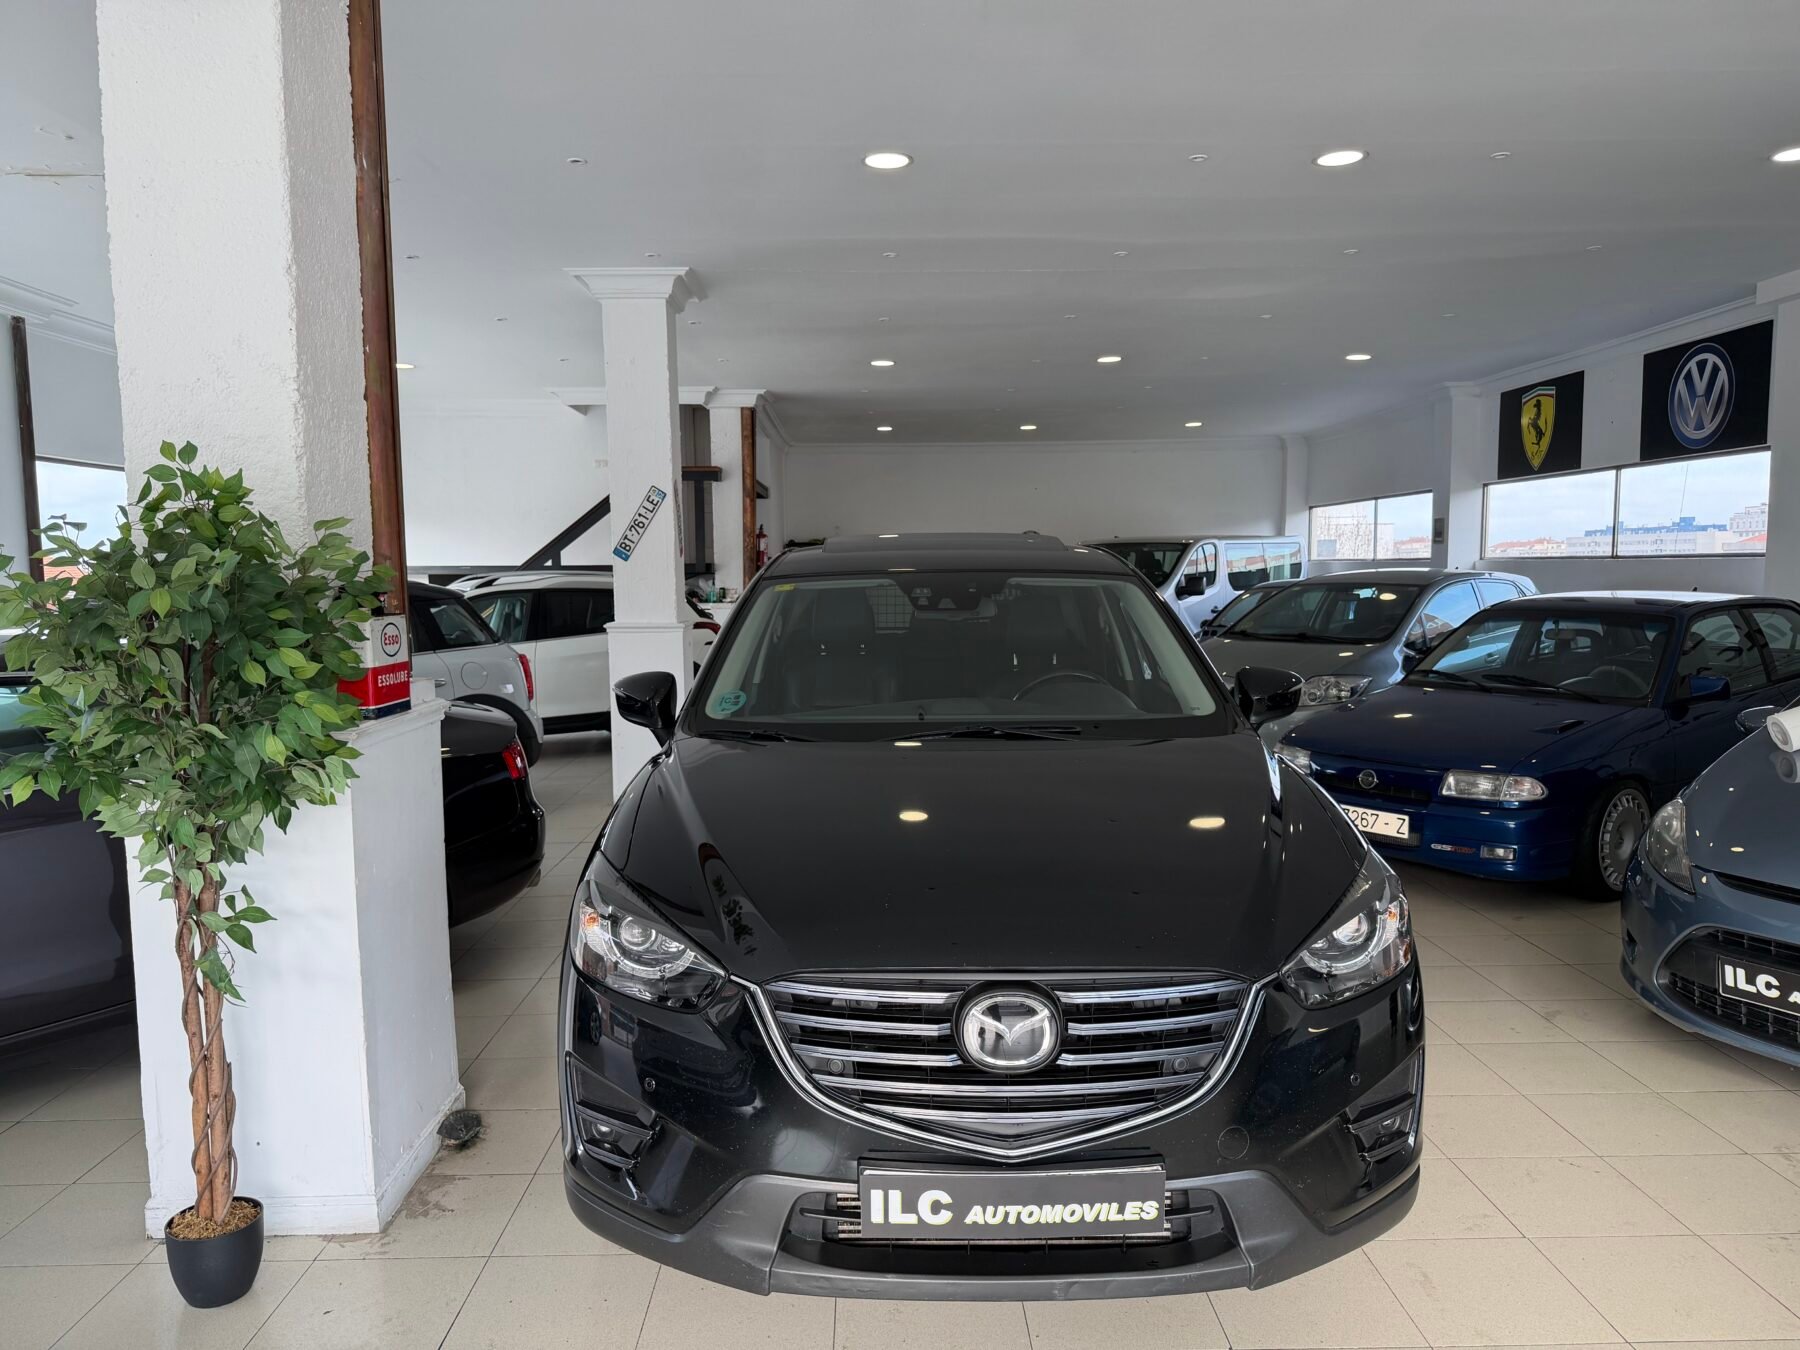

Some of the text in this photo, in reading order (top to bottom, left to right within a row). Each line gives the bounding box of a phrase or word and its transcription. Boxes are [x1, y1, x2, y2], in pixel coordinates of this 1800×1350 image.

[619, 494, 660, 553] BT-761-LE
[377, 670, 408, 687] ESSOLUBE
[1724, 964, 1781, 999] ILC
[870, 1189, 1159, 1225] ILC AUTOMOVILES
